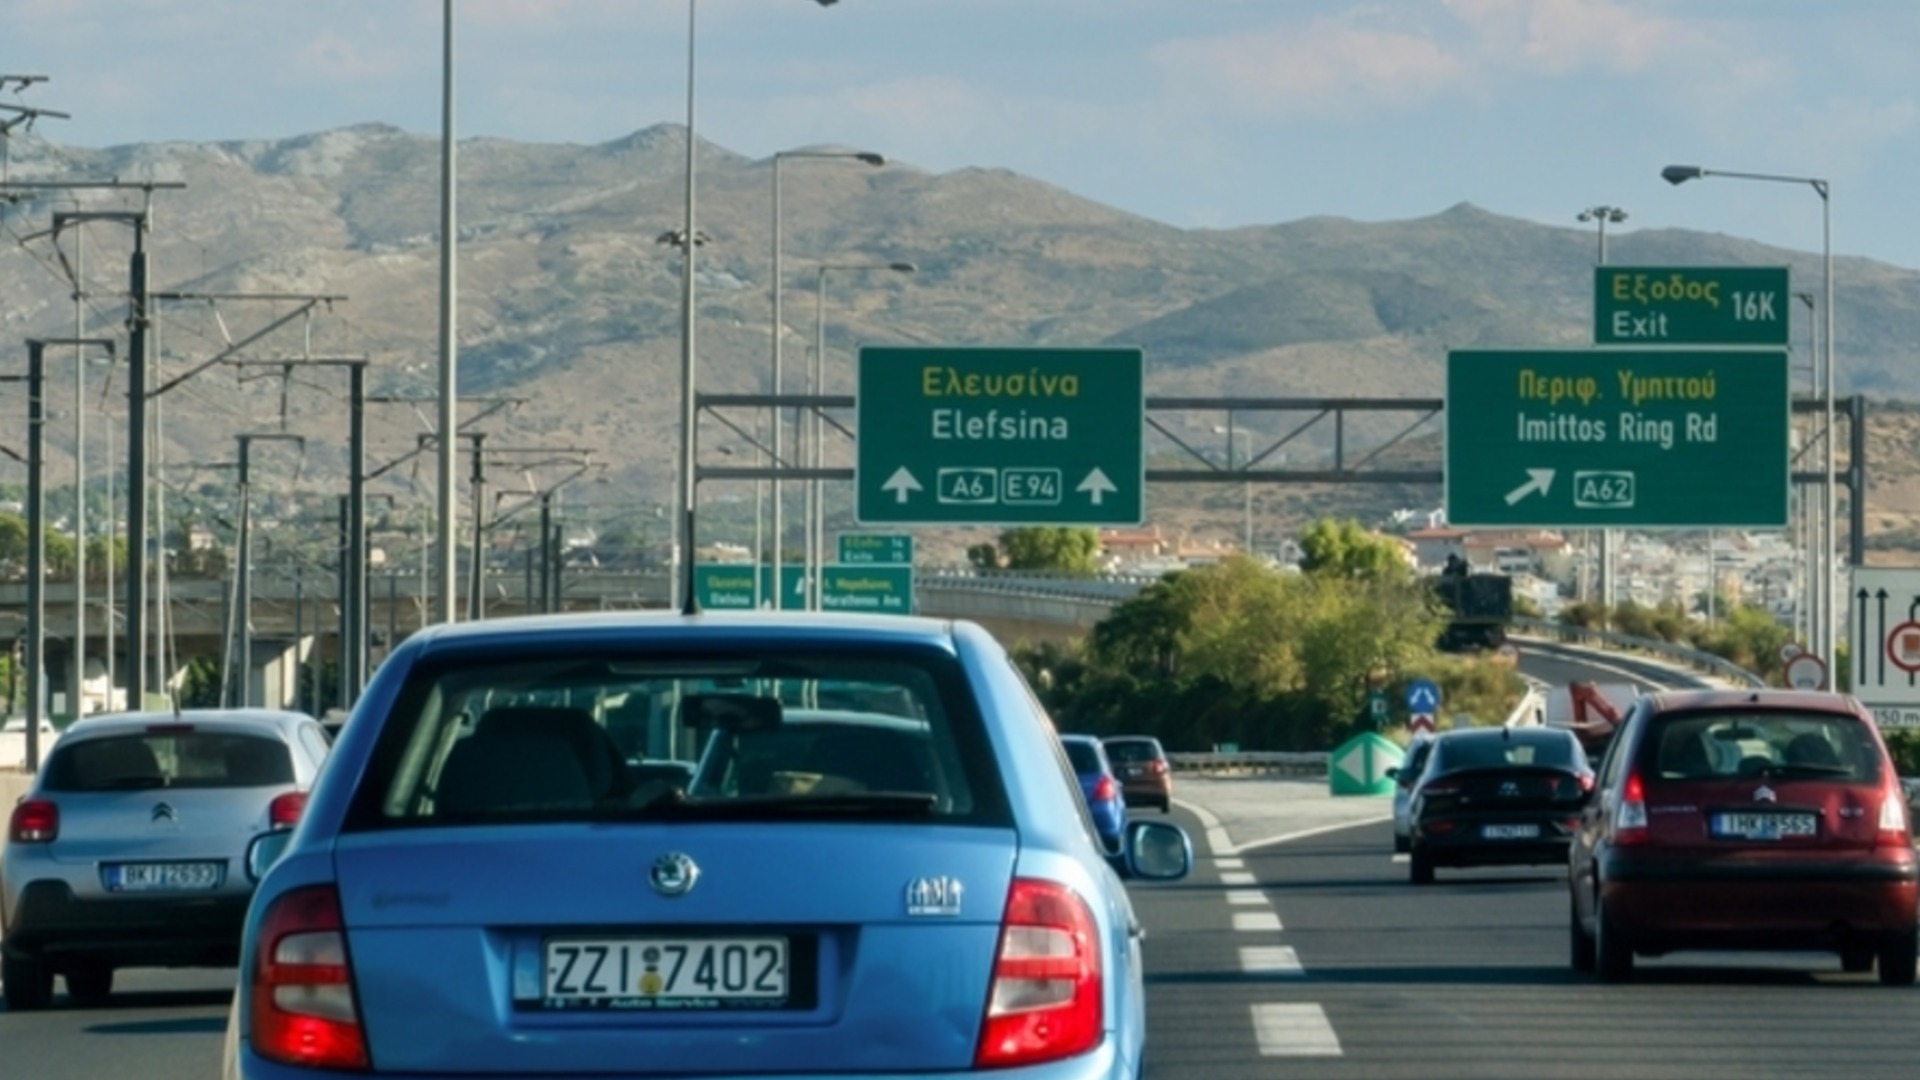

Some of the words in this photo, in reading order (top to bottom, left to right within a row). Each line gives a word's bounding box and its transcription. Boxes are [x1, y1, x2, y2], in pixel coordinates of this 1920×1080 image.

[1732, 291, 1776, 321] 16K
[1612, 311, 1668, 338] Exit
[921, 366, 1079, 397] Ελευσίνα
[1518, 369, 1603, 406] Περιφ.
[1617, 369, 1717, 406] Υμηττού
[931, 408, 1069, 440] Elefsina
[1518, 412, 1607, 442] Imittos
[1618, 412, 1674, 450] Ring
[1685, 412, 1718, 442] Rd
[951, 475, 984, 497] A6
[1007, 475, 1022, 497] E
[1027, 475, 1055, 497] 94
[1581, 478, 1629, 501] A62
[1874, 709, 1899, 724] 150
[553, 945, 629, 994] ZZI
[662, 944, 779, 993] 7402
